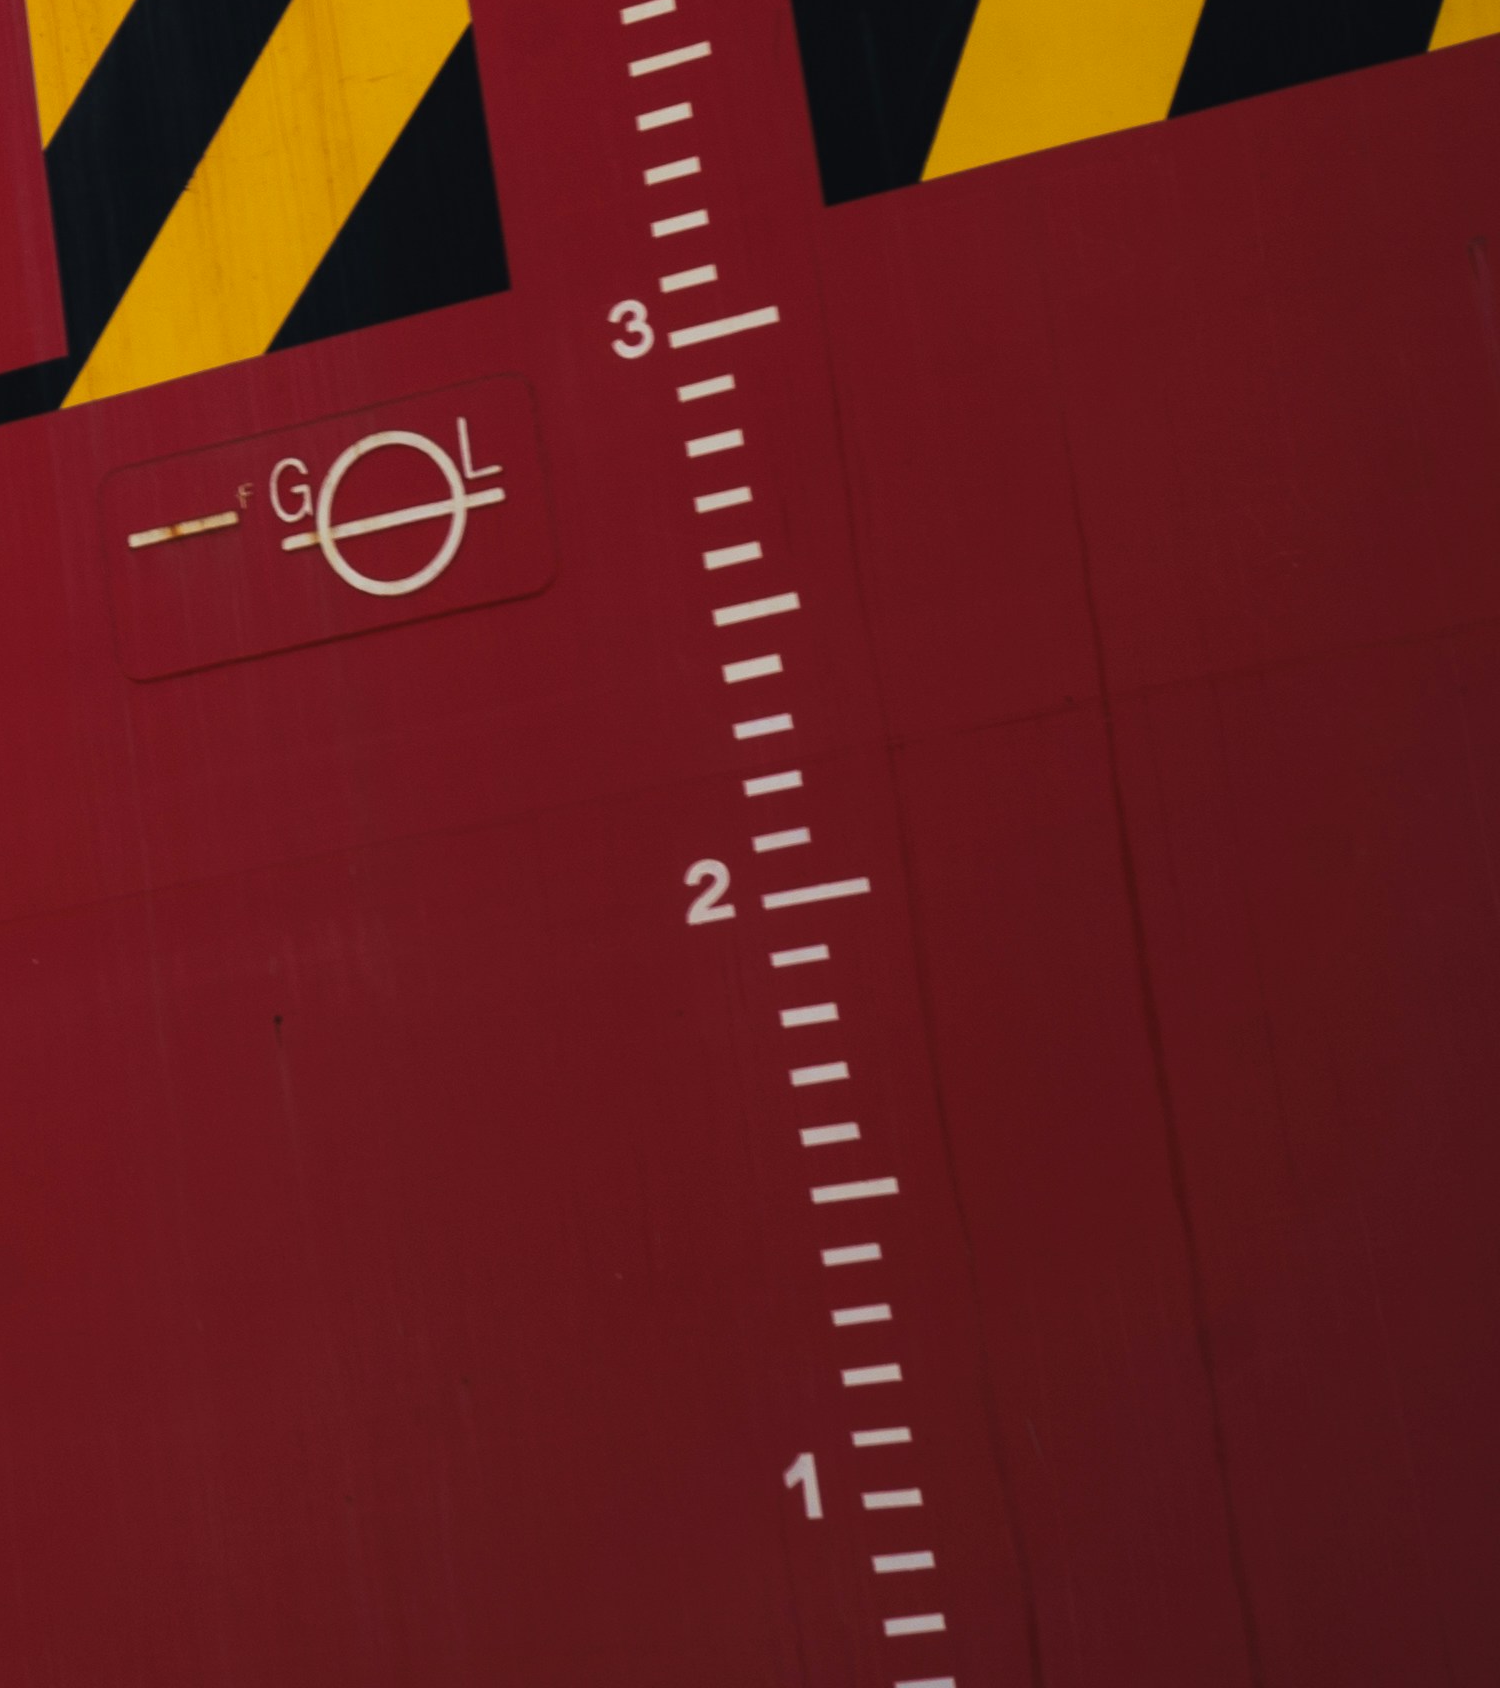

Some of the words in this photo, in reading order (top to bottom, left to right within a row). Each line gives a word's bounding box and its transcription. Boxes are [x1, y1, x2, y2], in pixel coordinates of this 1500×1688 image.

[606, 299, 655, 359] 3
[269, 457, 313, 524] G
[456, 416, 503, 480] L
[684, 858, 737, 925] 2
[783, 1452, 824, 1519] 1
